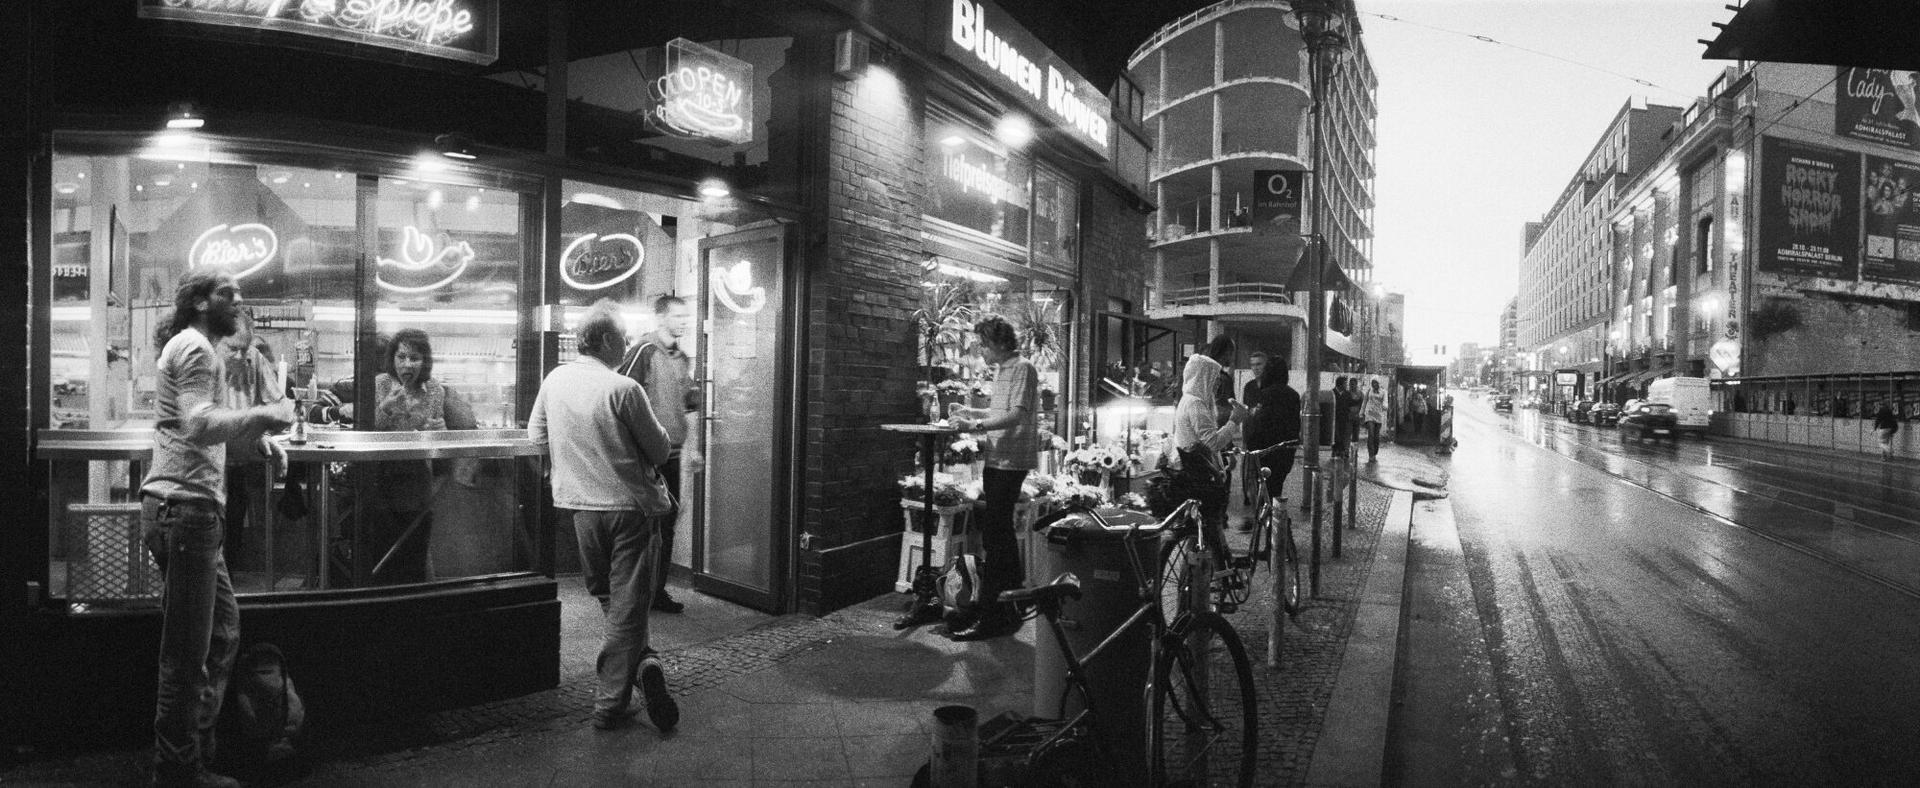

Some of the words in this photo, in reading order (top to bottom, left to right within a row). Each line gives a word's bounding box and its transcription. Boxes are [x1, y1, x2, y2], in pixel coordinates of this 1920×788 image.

[679, 66, 742, 112] OPEN
[1847, 66, 1894, 116] Lady
[1786, 163, 1839, 195] ROCKY
[1781, 184, 1842, 218] HORROR
[1788, 206, 1833, 234] SHOW
[200, 237, 267, 265] Bier's
[1777, 248, 1824, 260] ADMIRALSPALAST
